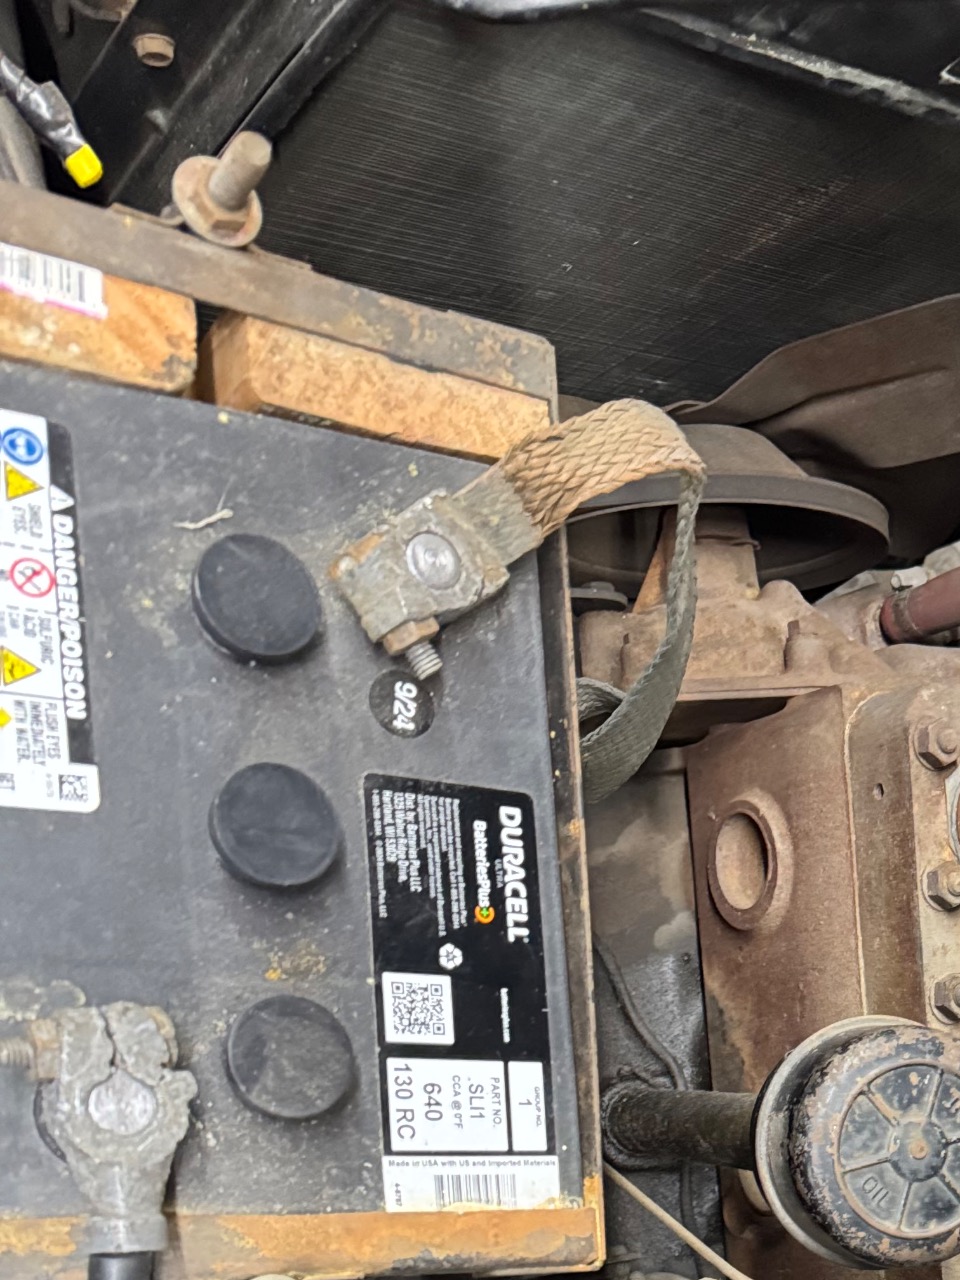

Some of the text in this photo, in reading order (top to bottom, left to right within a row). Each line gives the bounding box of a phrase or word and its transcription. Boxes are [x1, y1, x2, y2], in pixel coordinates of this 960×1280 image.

[52, 514, 87, 720] DANGER/POISON
[392, 681, 418, 731] 9/24
[46, 735, 61, 759] EYES
[385, 826, 396, 838] WI
[406, 824, 418, 859] Batteries
[396, 838, 408, 859] Ridge
[409, 860, 421, 876] Plus
[494, 858, 504, 889] ULTRA
[498, 805, 529, 943] DURACELL
[410, 877, 423, 893] LLC
[393, 1063, 416, 1140] 130 RC
[452, 1075, 462, 1097] CCA
[423, 1082, 444, 1122] 640
[490, 1077, 502, 1129] PART NO.
[518, 1098, 533, 1106] 1
[388, 1159, 410, 1167] Made
[422, 1159, 438, 1167] USA
[440, 1159, 457, 1167] with
[459, 1159, 470, 1167] US
[472, 1159, 486, 1167] and
[488, 1159, 521, 1169] Imported
[523, 1159, 556, 1167] Materials
[860, 1174, 891, 1207] OIL
